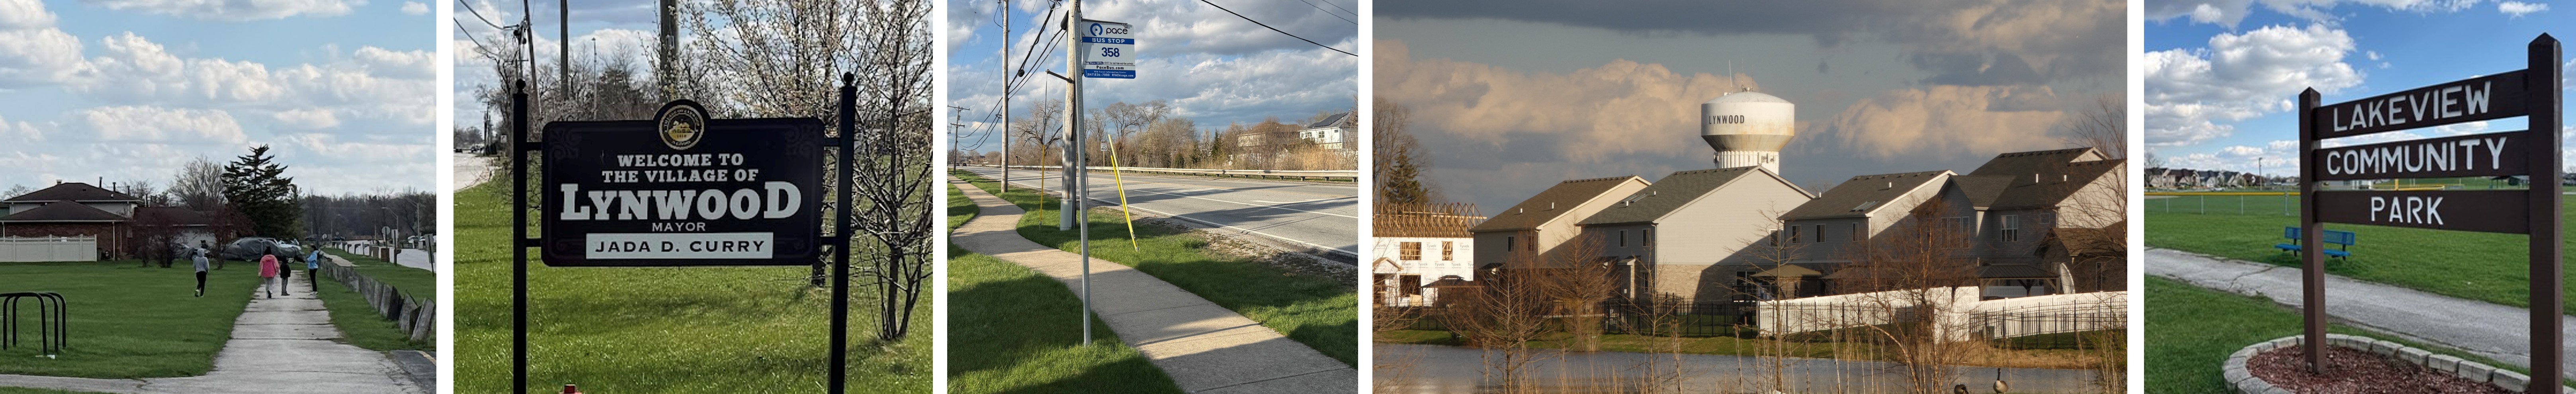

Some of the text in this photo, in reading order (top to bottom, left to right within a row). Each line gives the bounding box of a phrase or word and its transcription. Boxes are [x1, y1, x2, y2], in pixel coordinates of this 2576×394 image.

[1101, 47, 1120, 57] 358
[2334, 81, 2491, 132] LAKEVIEW
[1709, 115, 1745, 125] LYNWOOD
[617, 153, 743, 167] WELCOME TO
[2326, 137, 2507, 175] COMMUNITY
[602, 169, 758, 183] THE VILLAGE OF
[560, 181, 801, 220] LYNWOOD
[2371, 197, 2443, 225] PARK
[652, 222, 706, 232] MAYOR
[595, 241, 764, 252] JADA D. CURRY
